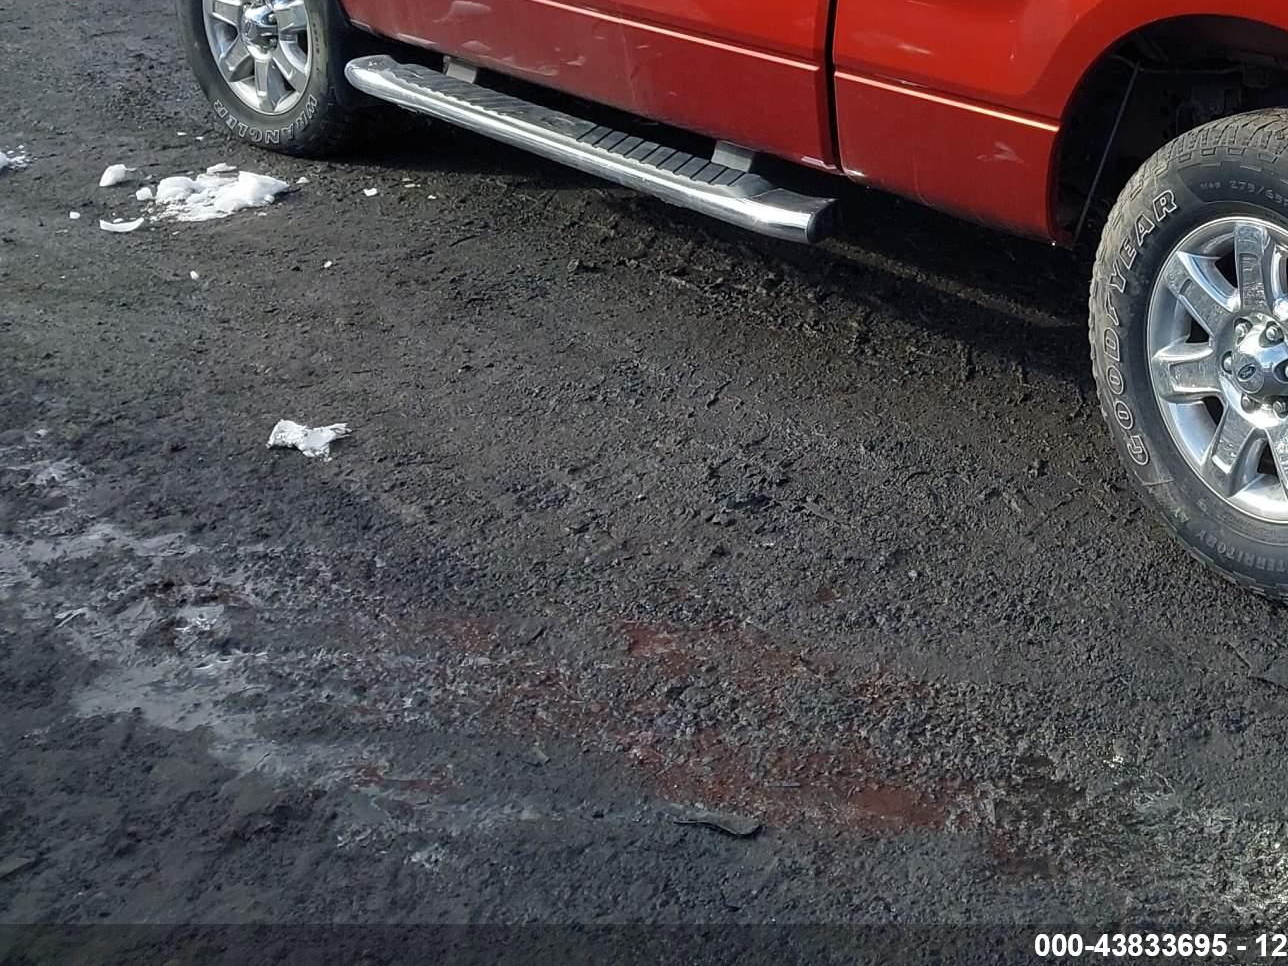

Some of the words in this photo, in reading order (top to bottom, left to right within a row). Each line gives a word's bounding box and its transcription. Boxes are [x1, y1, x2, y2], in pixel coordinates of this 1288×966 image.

[213, 94, 318, 144] WRANGLER
[1103, 189, 1177, 466] GOODYEAR
[1195, 529, 1286, 573] TERRITORY
